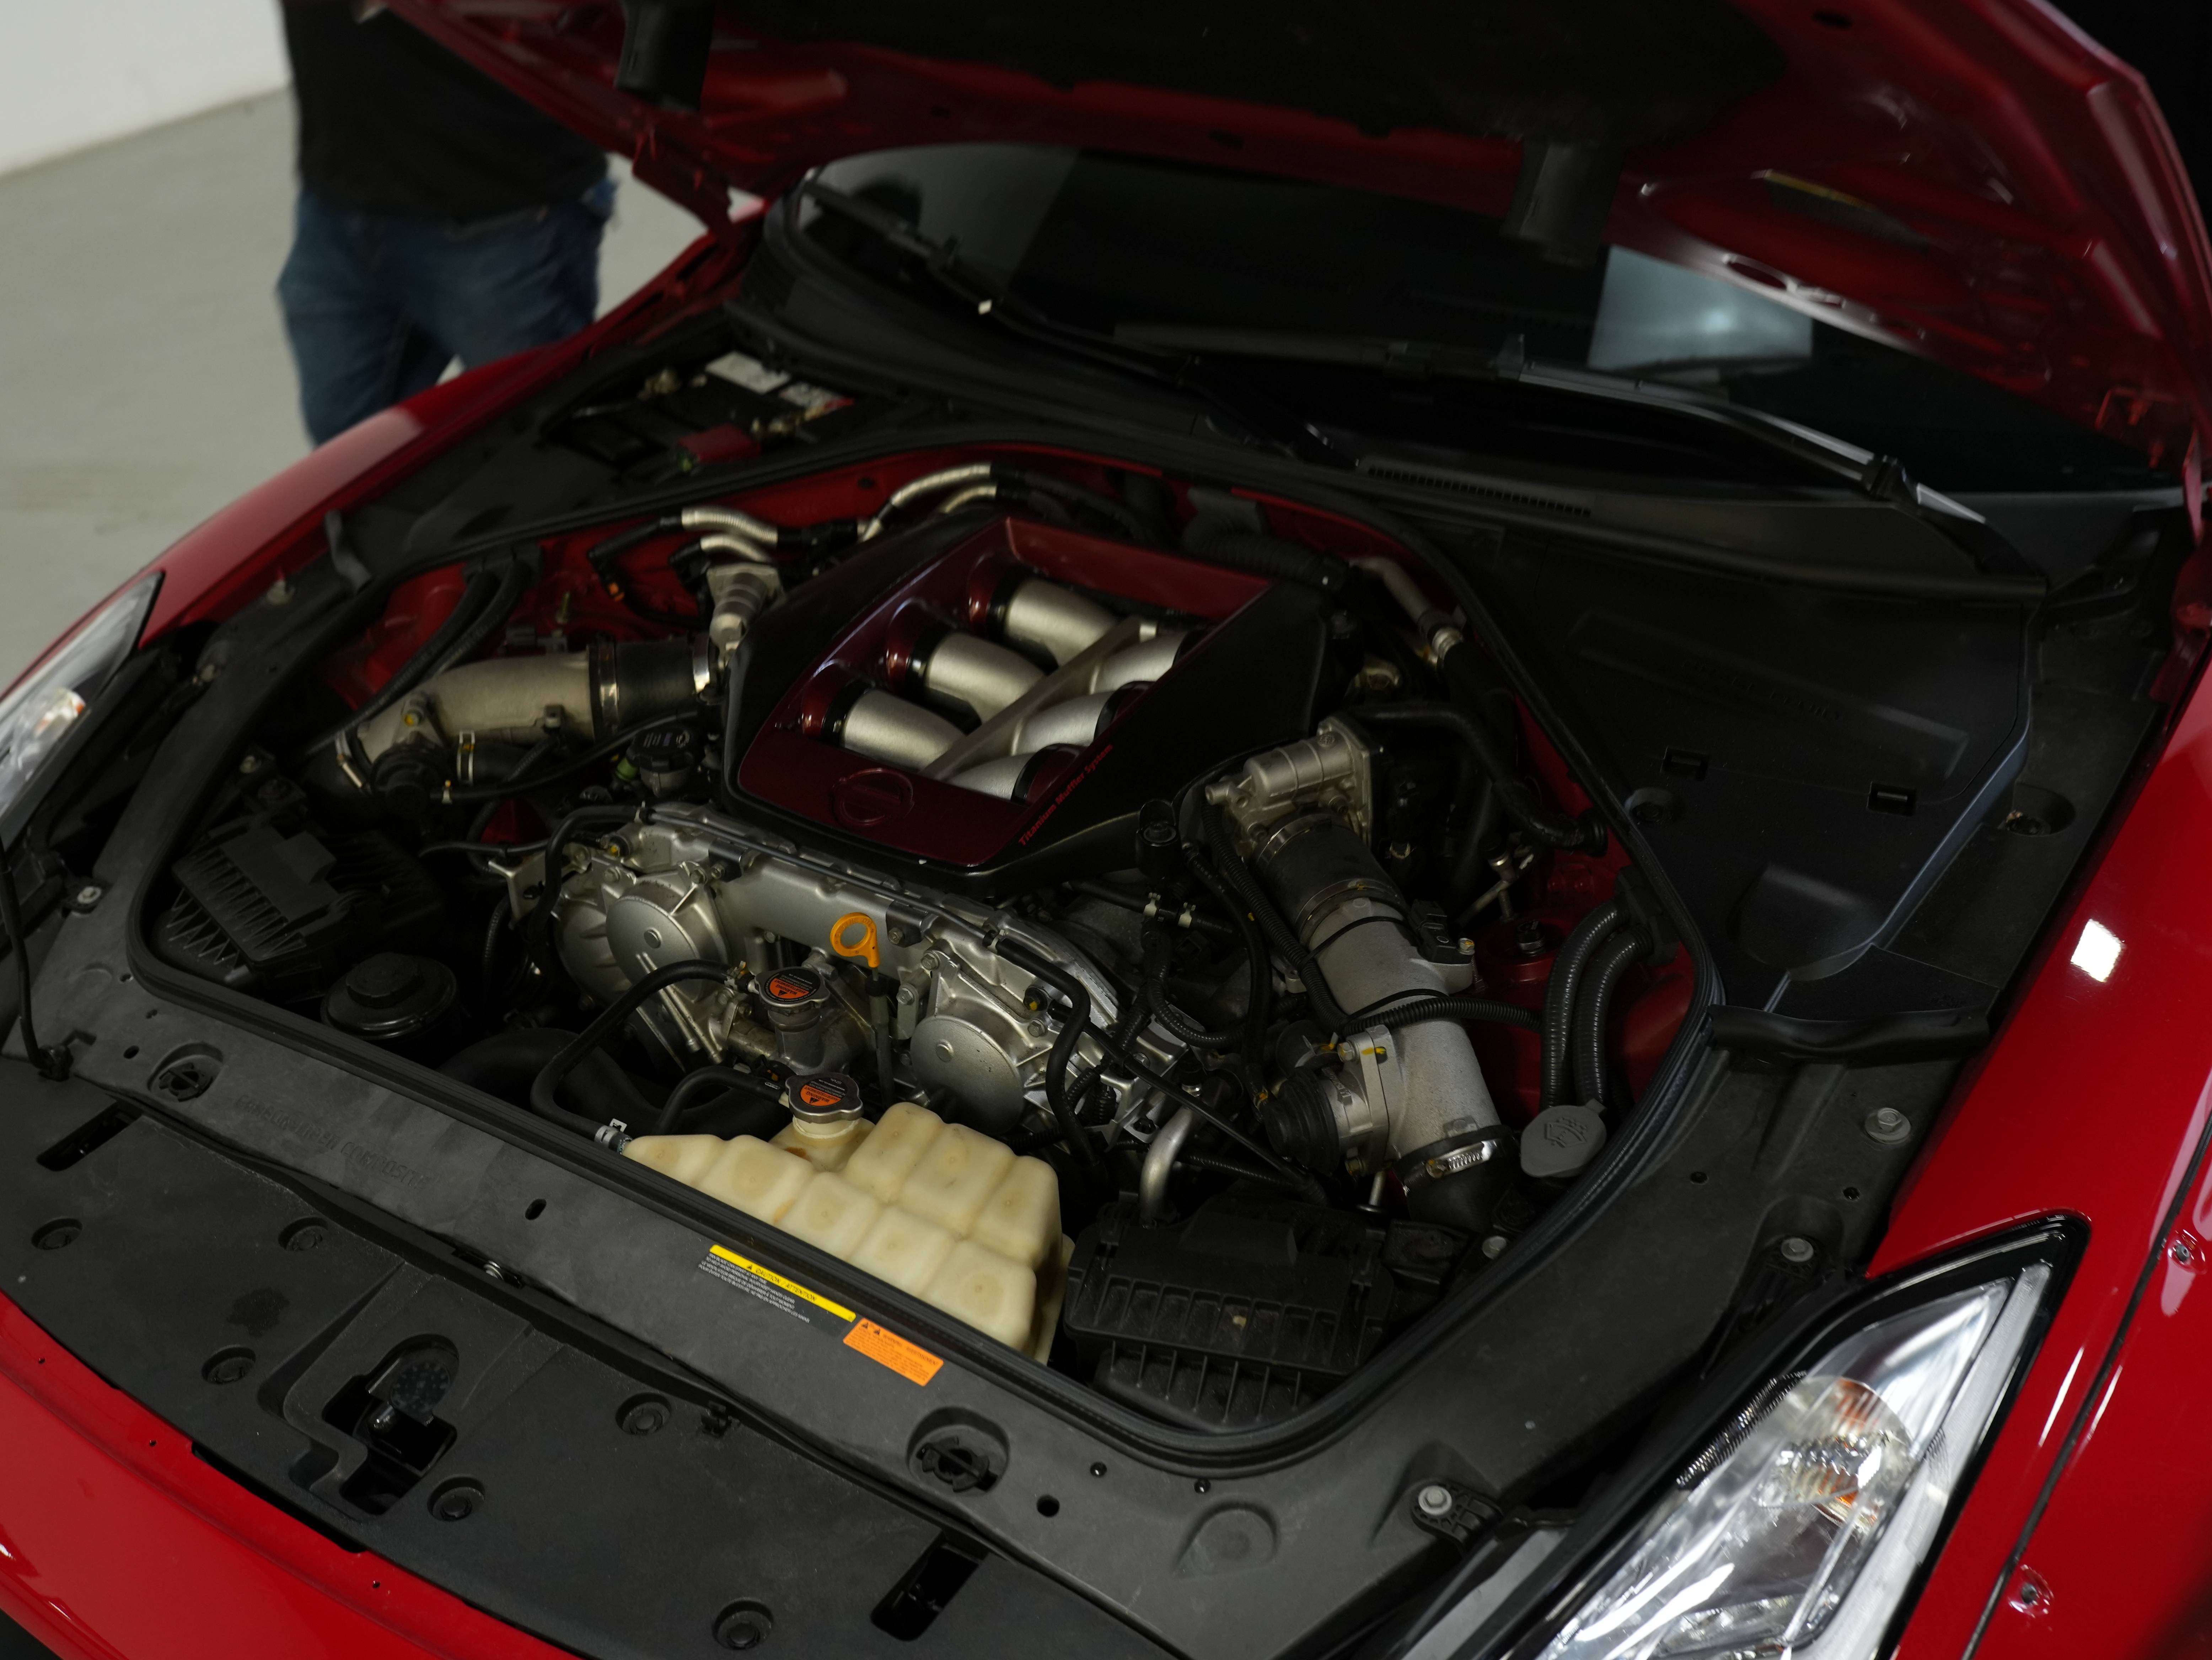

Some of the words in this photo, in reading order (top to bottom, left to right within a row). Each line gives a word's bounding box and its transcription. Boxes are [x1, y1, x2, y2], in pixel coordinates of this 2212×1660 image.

[1018, 804, 1057, 845] Titanium
[1055, 773, 1084, 805] Muffler
[1084, 744, 1113, 773] System
[774, 980, 806, 993] AVERTISSEMENT
[776, 984, 797, 995] WARNING
[806, 1092, 830, 1103] WARNING
[756, 1268, 781, 1283] CAUTION
[786, 1283, 817, 1302] ATTENTION
